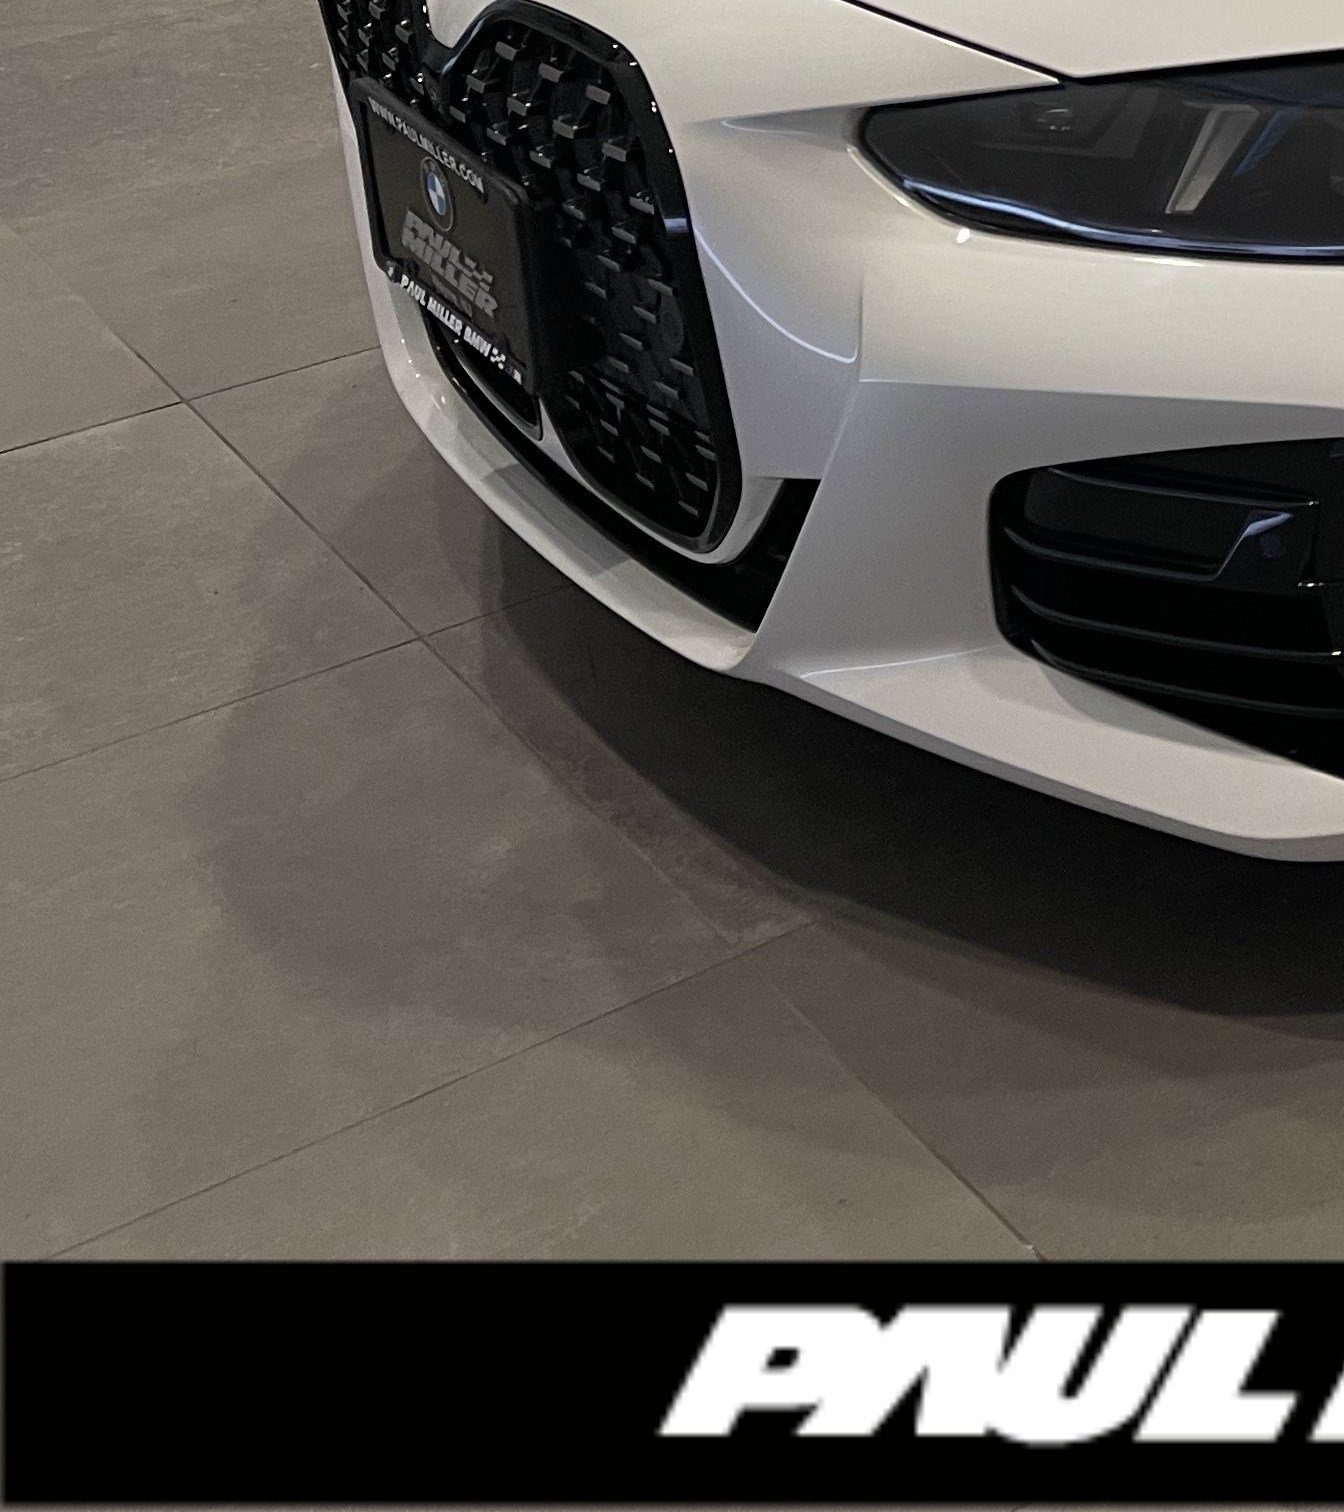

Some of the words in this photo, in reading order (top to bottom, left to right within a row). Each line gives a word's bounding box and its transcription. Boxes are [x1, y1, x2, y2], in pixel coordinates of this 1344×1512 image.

[402, 226, 498, 318] MILLER
[403, 208, 473, 278] PAUL
[400, 273, 426, 307] PAUL
[426, 296, 463, 337] MILLER
